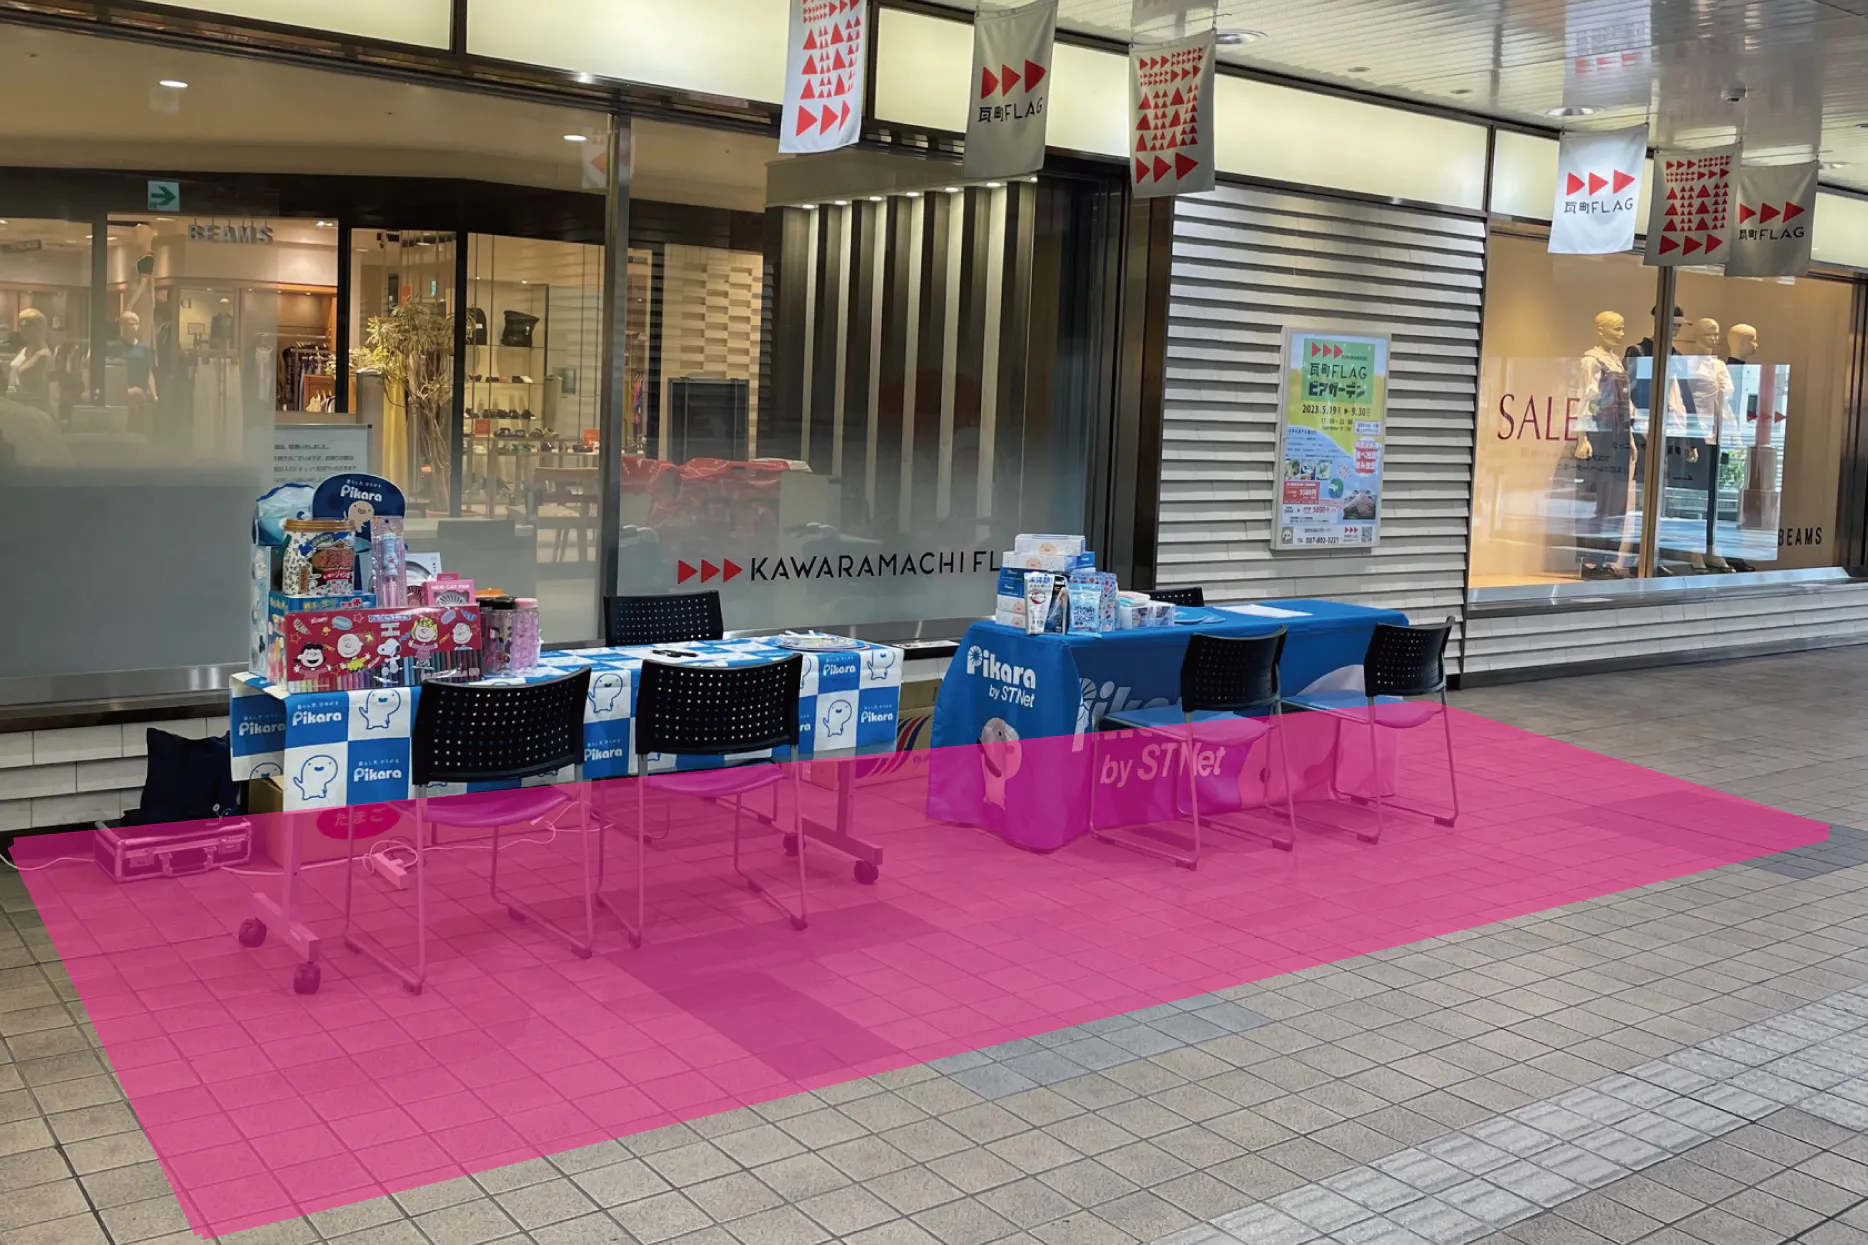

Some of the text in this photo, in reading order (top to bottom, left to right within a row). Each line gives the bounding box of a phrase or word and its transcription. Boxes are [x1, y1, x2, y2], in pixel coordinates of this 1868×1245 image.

[978, 96, 1043, 123] 瓦町FLAG
[1563, 197, 1634, 214] 瓦町FLAG
[188, 224, 275, 244] BEAMS
[1738, 226, 1806, 241] 瓦町FLAG
[1496, 393, 1581, 441] SALE
[340, 484, 383, 502] Pikara
[1777, 526, 1823, 547] BEAMS
[750, 550, 1001, 582] KAWARAMACHI FL
[823, 664, 856, 677] Pikara
[966, 645, 1036, 690] Pikara
[989, 684, 1035, 708] by STNet
[292, 711, 342, 727] Pikara
[861, 711, 894, 724] Pikara
[238, 722, 286, 737] Pikara
[584, 747, 623, 762] Pikara
[1100, 742, 1226, 788] by STNet
[353, 767, 402, 782] Pikara
